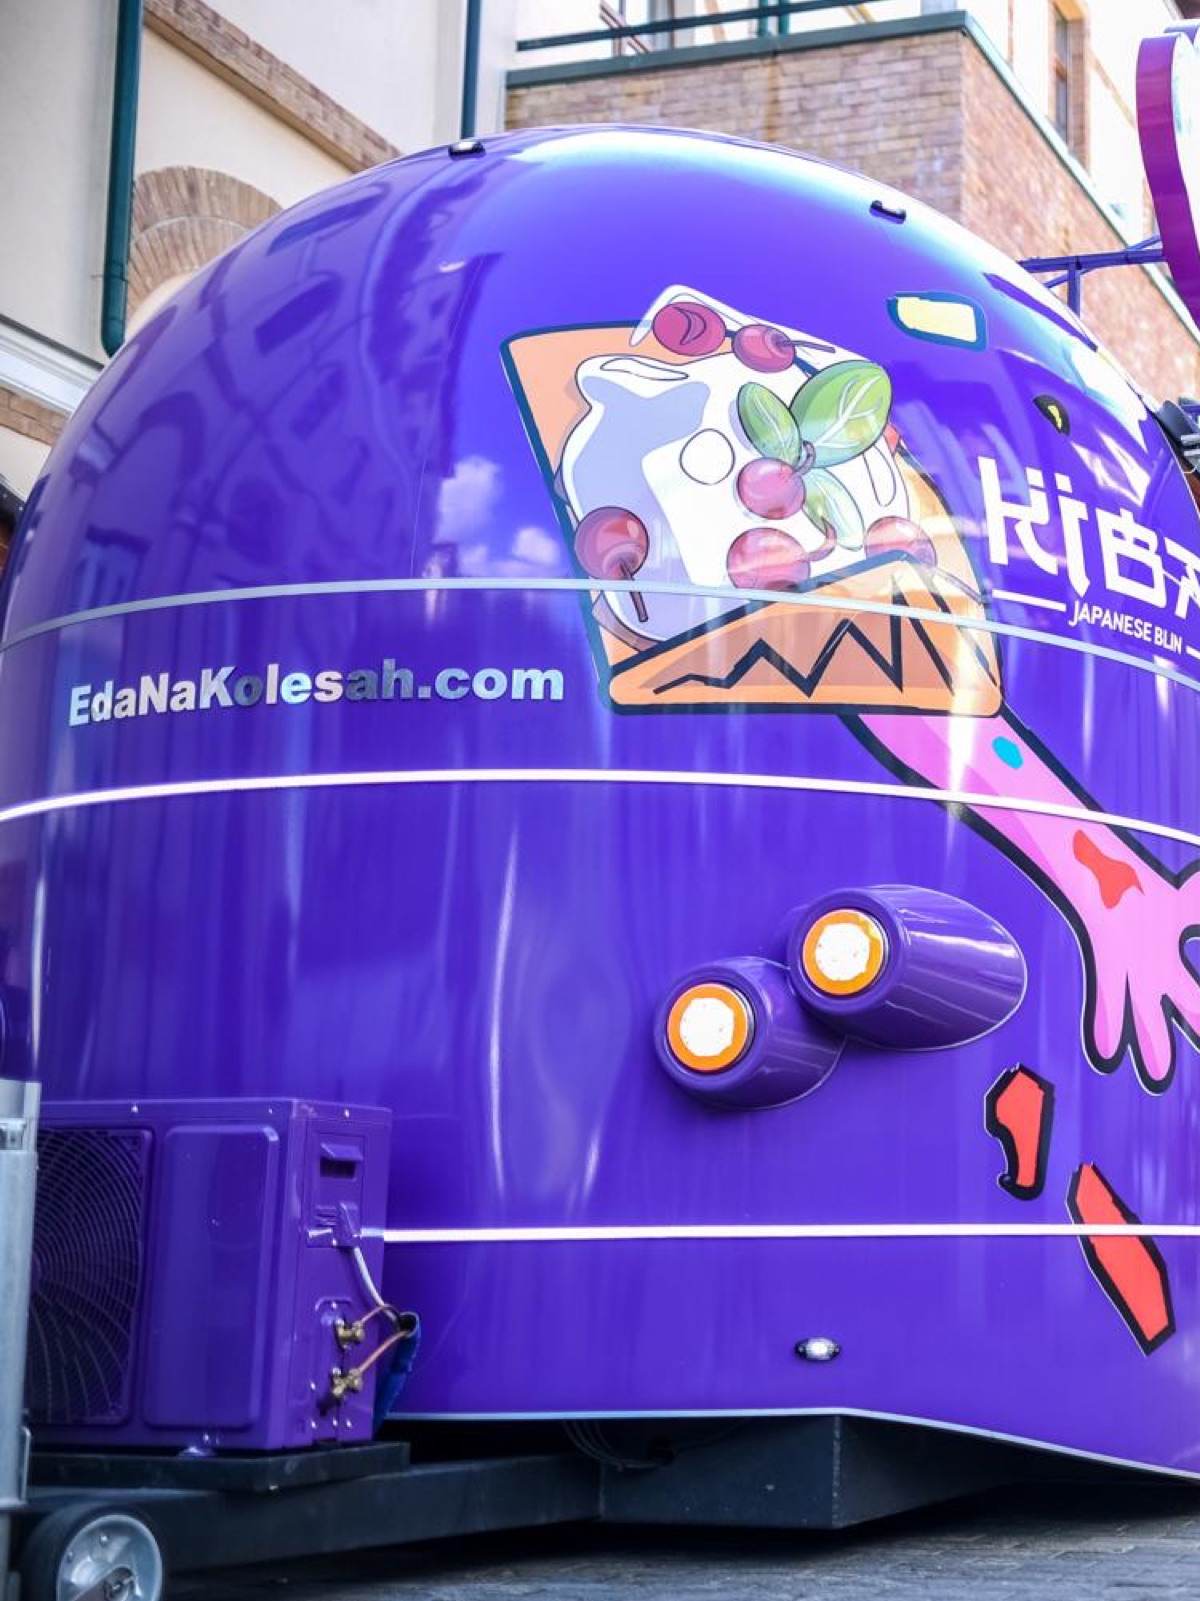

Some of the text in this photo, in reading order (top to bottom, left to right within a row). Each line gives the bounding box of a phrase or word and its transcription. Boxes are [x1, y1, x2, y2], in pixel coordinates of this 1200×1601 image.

[1068, 600, 1182, 654] JAPANESE BLIN
[69, 658, 564, 728] EdaNaKolesah.com
